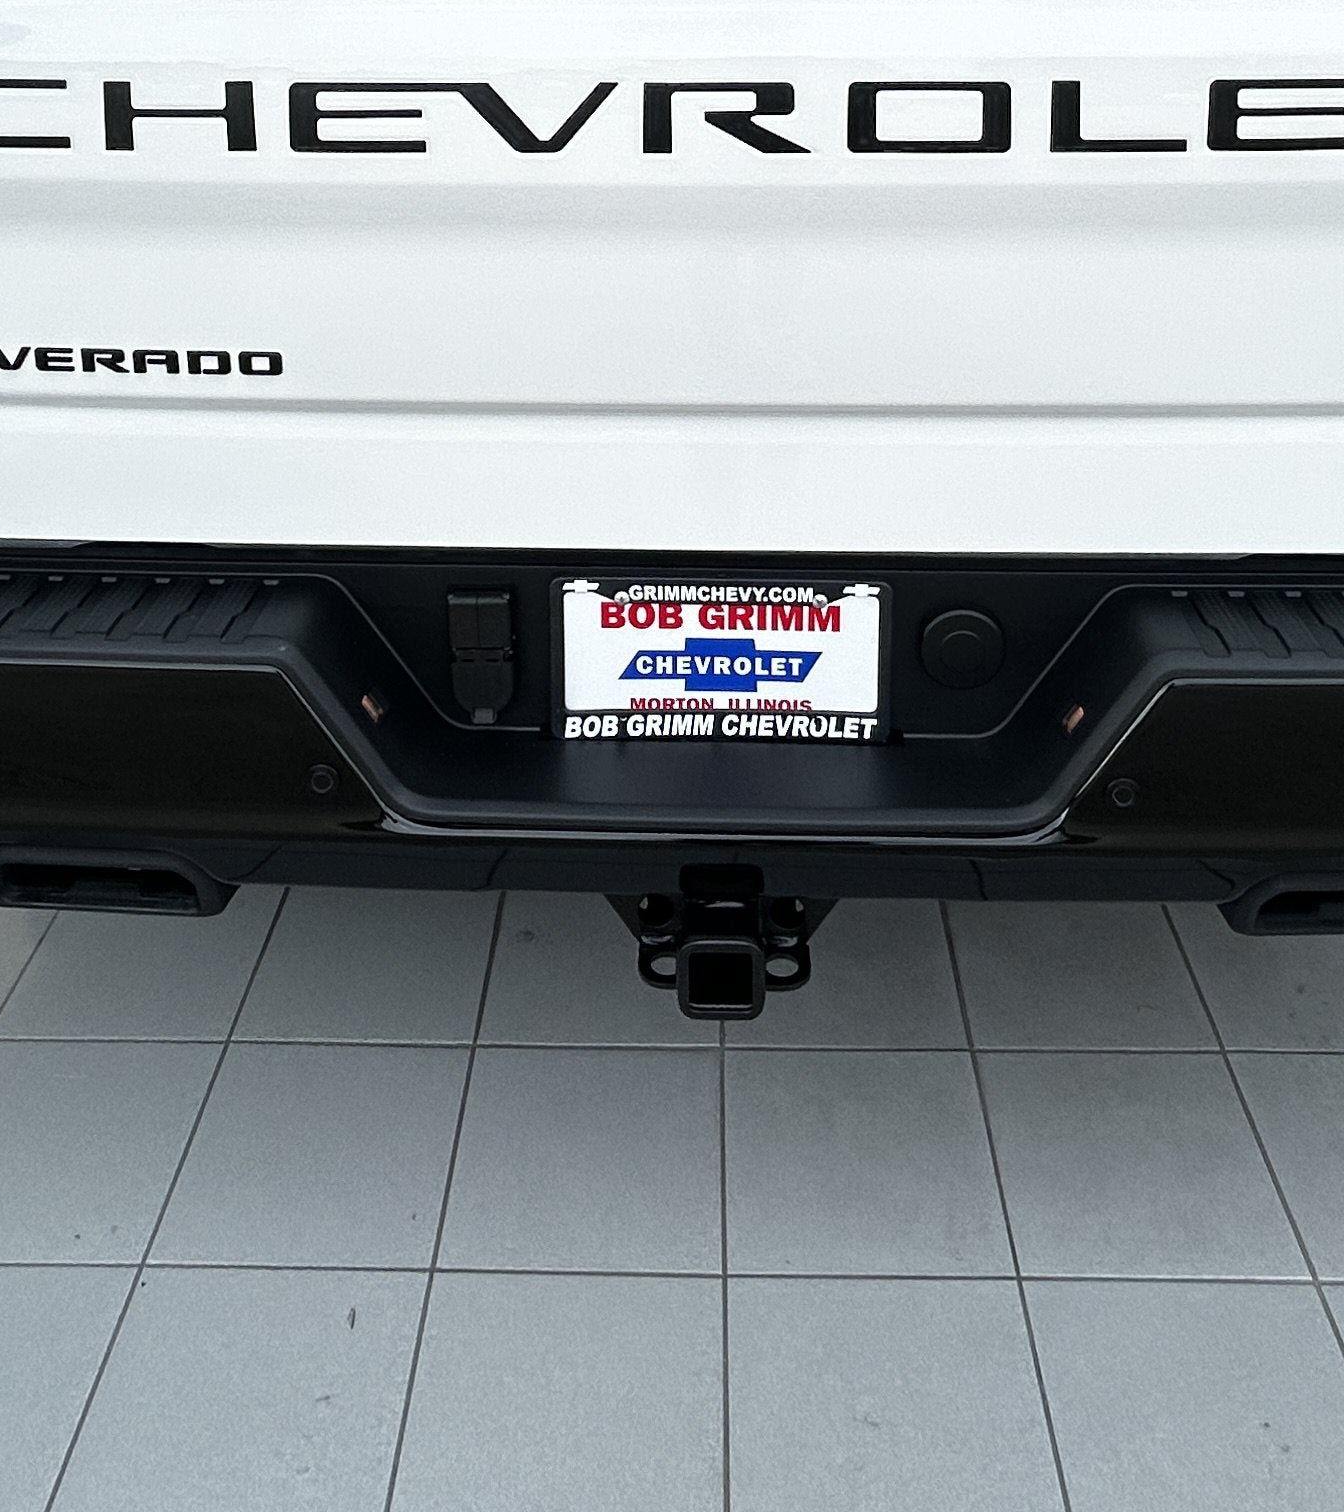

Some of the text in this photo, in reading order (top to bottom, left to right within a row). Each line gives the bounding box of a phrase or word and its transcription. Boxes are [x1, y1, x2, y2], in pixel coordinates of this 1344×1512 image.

[628, 585, 814, 603] GRIMMCHEVY.COM
[601, 602, 841, 633] BOB GRIMM
[636, 655, 803, 677] CHEVROLET
[630, 697, 714, 711] MORTON
[564, 714, 878, 739] BOB GRIMM CHEVROLET
